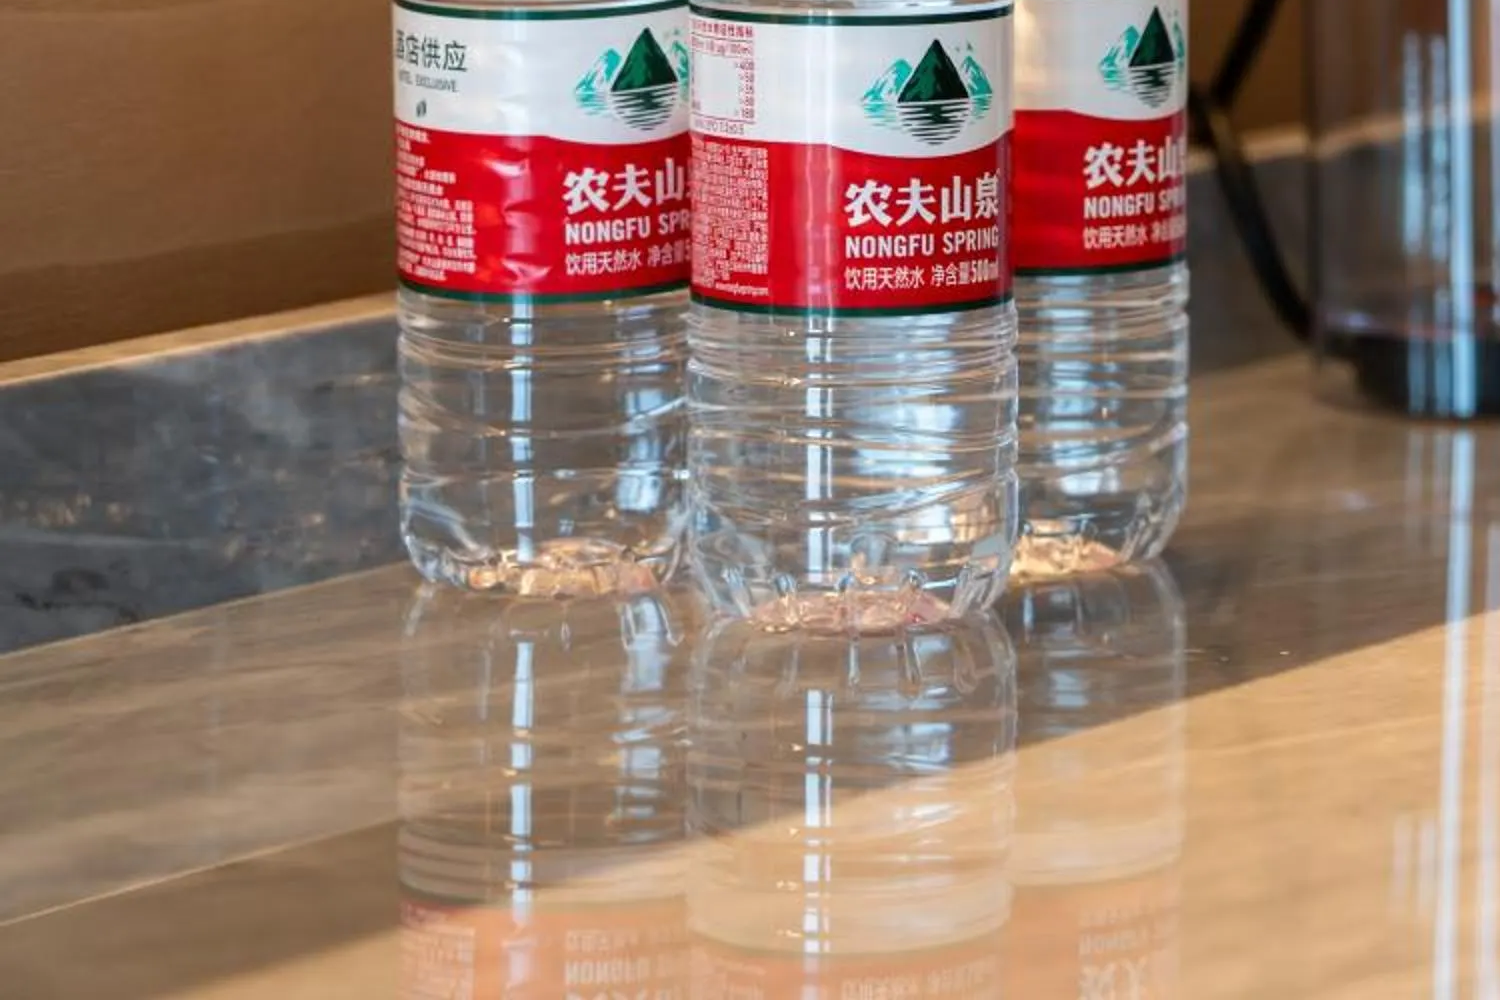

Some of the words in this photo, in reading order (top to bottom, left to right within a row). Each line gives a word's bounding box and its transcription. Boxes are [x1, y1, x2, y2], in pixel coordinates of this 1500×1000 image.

[1082, 135, 1186, 190] 农夫山
[562, 157, 691, 216] 农夫山
[844, 170, 999, 228] 农夫山泉
[1083, 192, 1155, 220] NONGFU
[564, 215, 651, 246] NONGFU
[845, 233, 935, 259] NONGFU
[942, 225, 999, 256] SPRING
[564, 248, 643, 277] 饮用天然水
[844, 264, 925, 291] 饮用天然水
